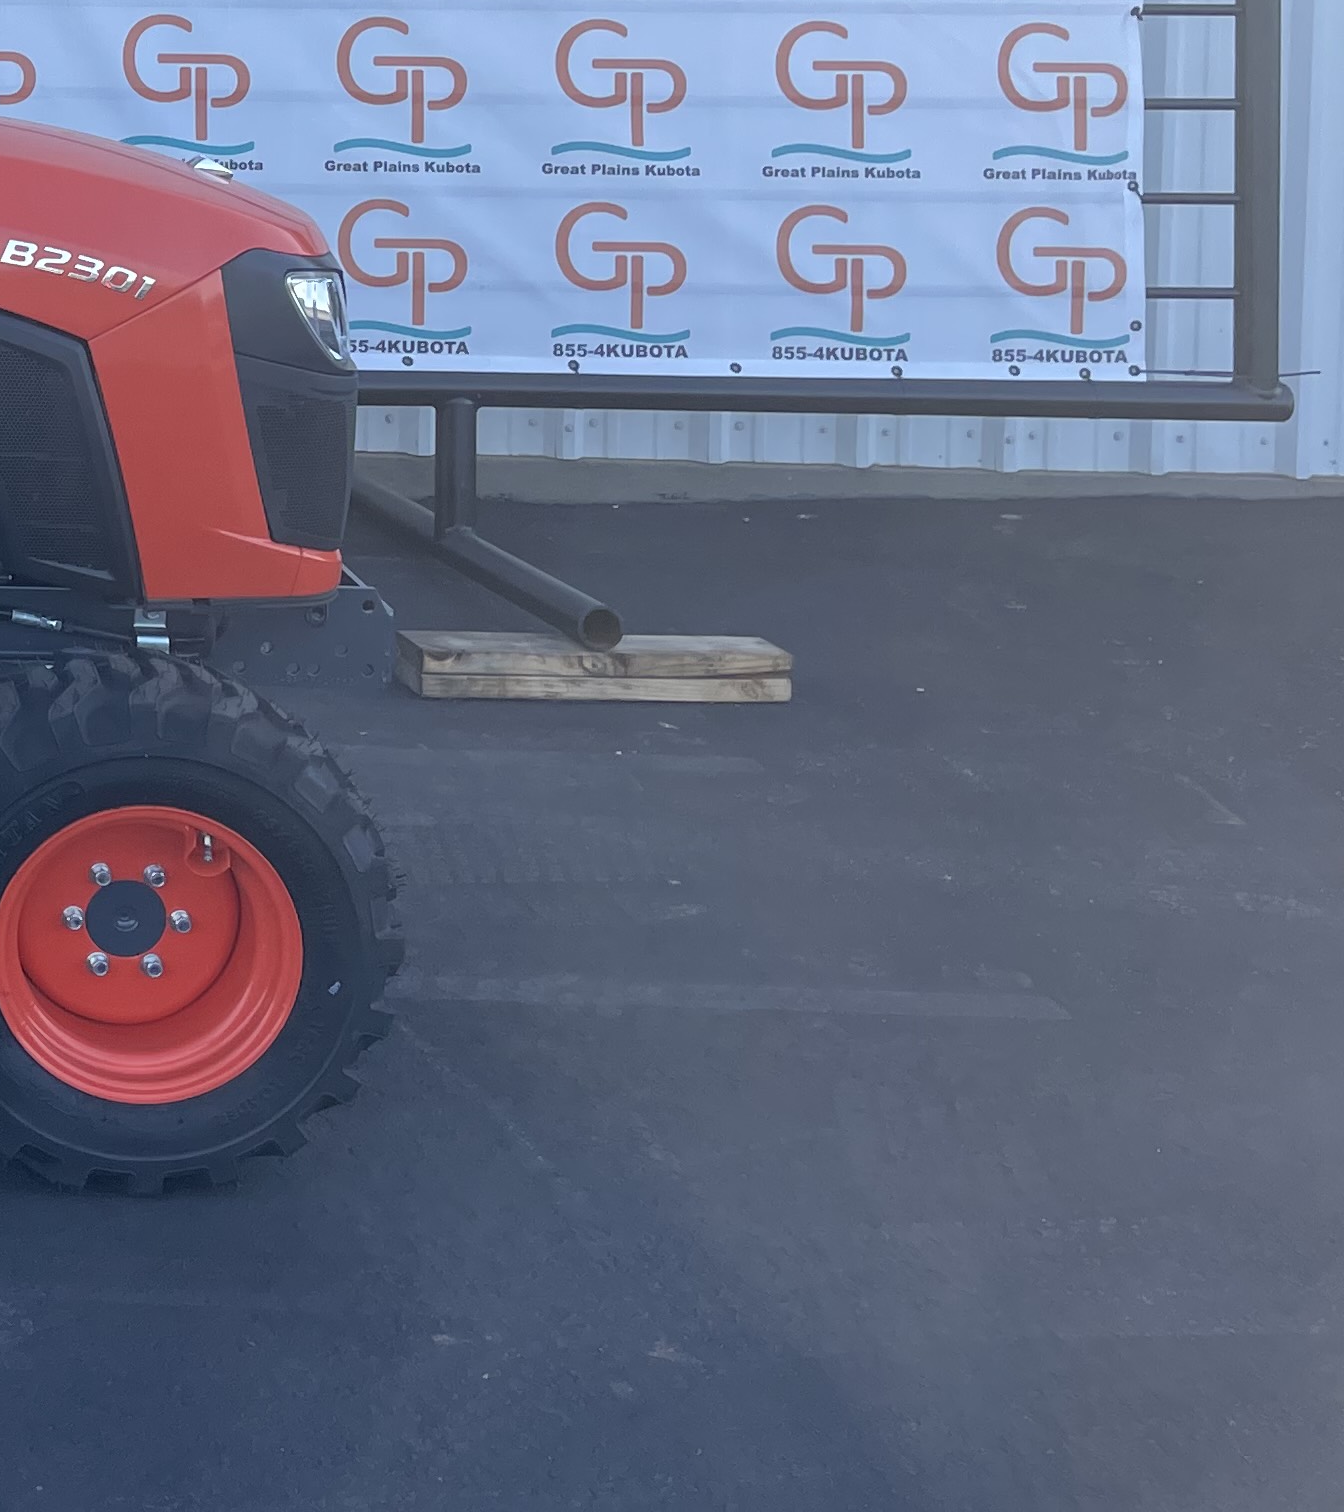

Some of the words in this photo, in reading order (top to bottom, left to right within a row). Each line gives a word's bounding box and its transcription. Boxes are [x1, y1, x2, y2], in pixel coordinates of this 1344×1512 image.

[123, 14, 250, 140] GP
[337, 17, 467, 143] GP
[556, 20, 686, 146] GP
[776, 21, 907, 148] GP
[998, 24, 1128, 151] GP
[325, 161, 368, 172] Great
[374, 161, 419, 172] Plains
[425, 162, 480, 173] Kubota
[542, 163, 586, 174] Great
[592, 164, 639, 175] Plains
[645, 165, 700, 176] Kubota
[762, 166, 806, 177] Great
[811, 167, 859, 178] Plains
[865, 167, 920, 178] Kubota
[983, 168, 1027, 180] Great
[1031, 169, 1082, 181] Plains
[1087, 170, 1138, 182] Kubota
[0, 239, 156, 301] B2301
[338, 199, 469, 325] GP
[556, 202, 686, 328] GP
[777, 205, 906, 332] GP
[997, 207, 1126, 334] GP
[349, 340, 470, 355] 55-4KUBOTA
[552, 343, 688, 358] 855-4KUBOTA
[772, 345, 908, 361] 855-4KUBOTA
[992, 348, 1128, 364] 855-4KUBOTA
